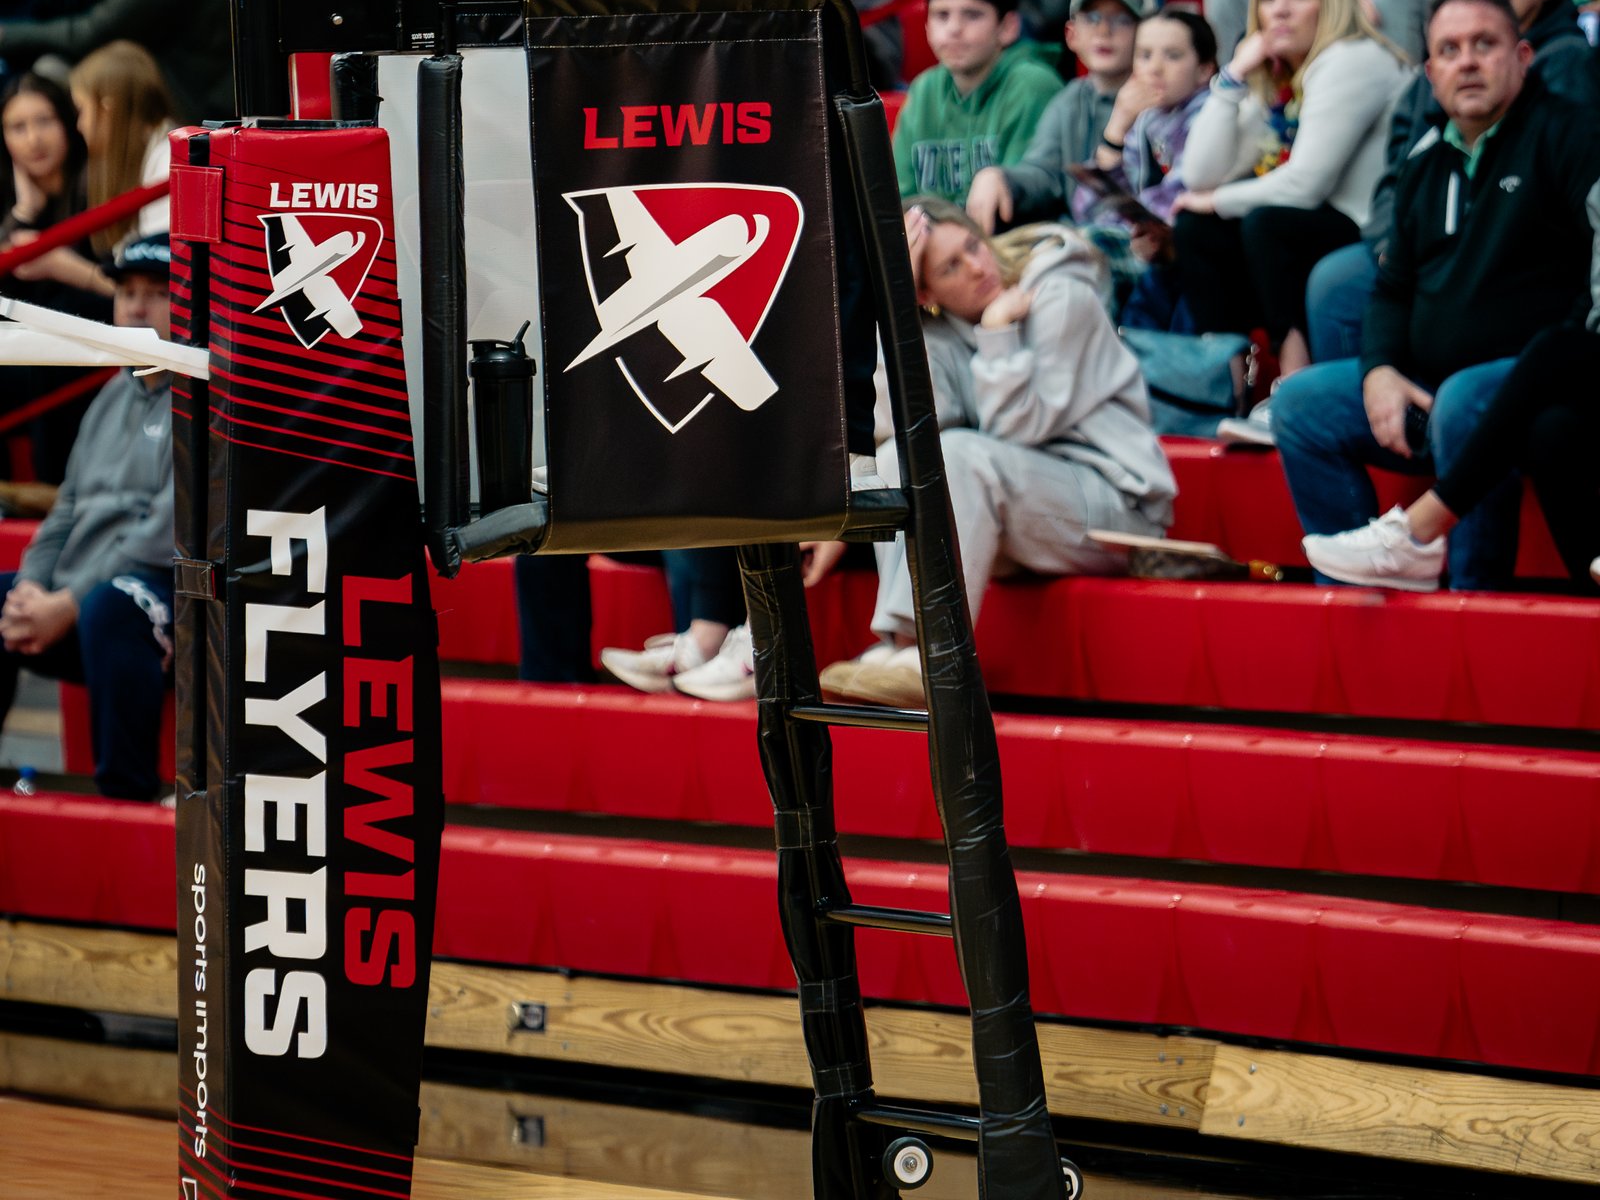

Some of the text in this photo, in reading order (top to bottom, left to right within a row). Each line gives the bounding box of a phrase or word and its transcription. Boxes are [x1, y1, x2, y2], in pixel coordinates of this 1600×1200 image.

[269, 182, 379, 209] LEWIS
[584, 102, 772, 150] LEWIS
[244, 505, 328, 1060] FLYERS
[342, 573, 416, 988] LEWIS
[191, 862, 208, 1159] sports imports
